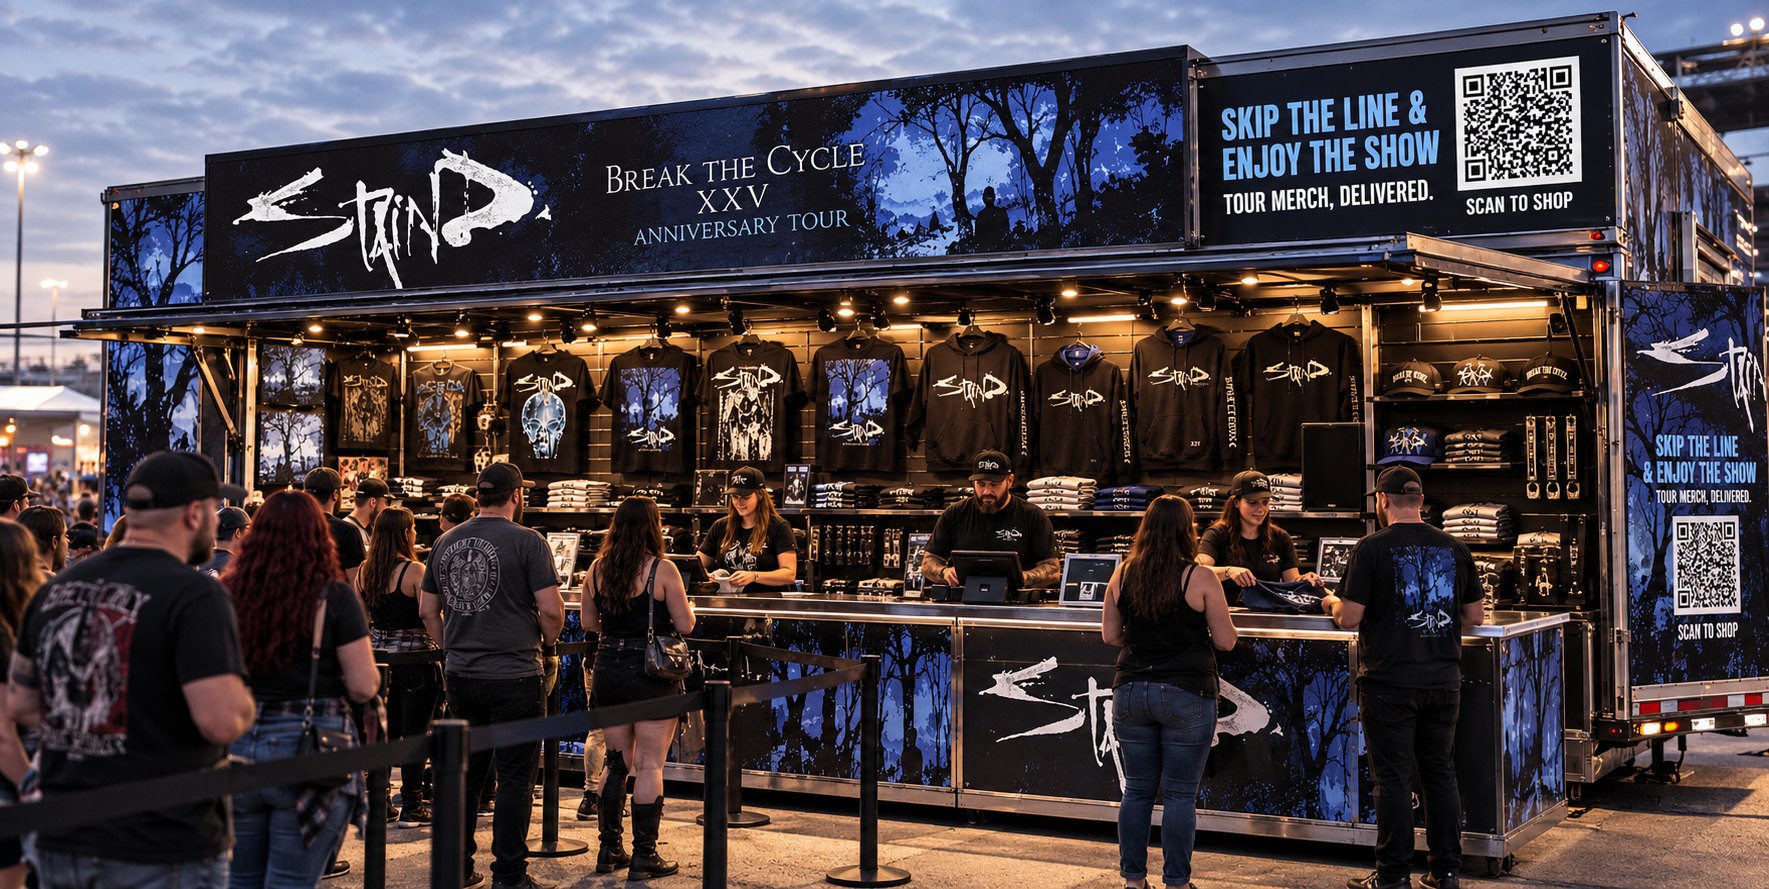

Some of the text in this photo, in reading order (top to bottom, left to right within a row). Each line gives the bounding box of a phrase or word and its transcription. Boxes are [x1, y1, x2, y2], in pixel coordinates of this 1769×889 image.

[1221, 89, 1427, 141] SKIP THE LINE &
[1222, 129, 1440, 181] ENJOY THE SHOW
[696, 183, 771, 215] XXV
[1223, 179, 1434, 215] TOUR MERCH, DELIVERED.
[1466, 191, 1574, 216] SCAN TO SHOP
[633, 209, 850, 247] ANNIVERSARY TOUR
[1655, 434, 1739, 458] SKIP THE LINE
[1643, 461, 1757, 484] & ENJOY THE SHOW
[1656, 489, 1752, 506] TOUR MERCH, DELIVERED.
[1677, 621, 1739, 641] SCAN TO SHOP
